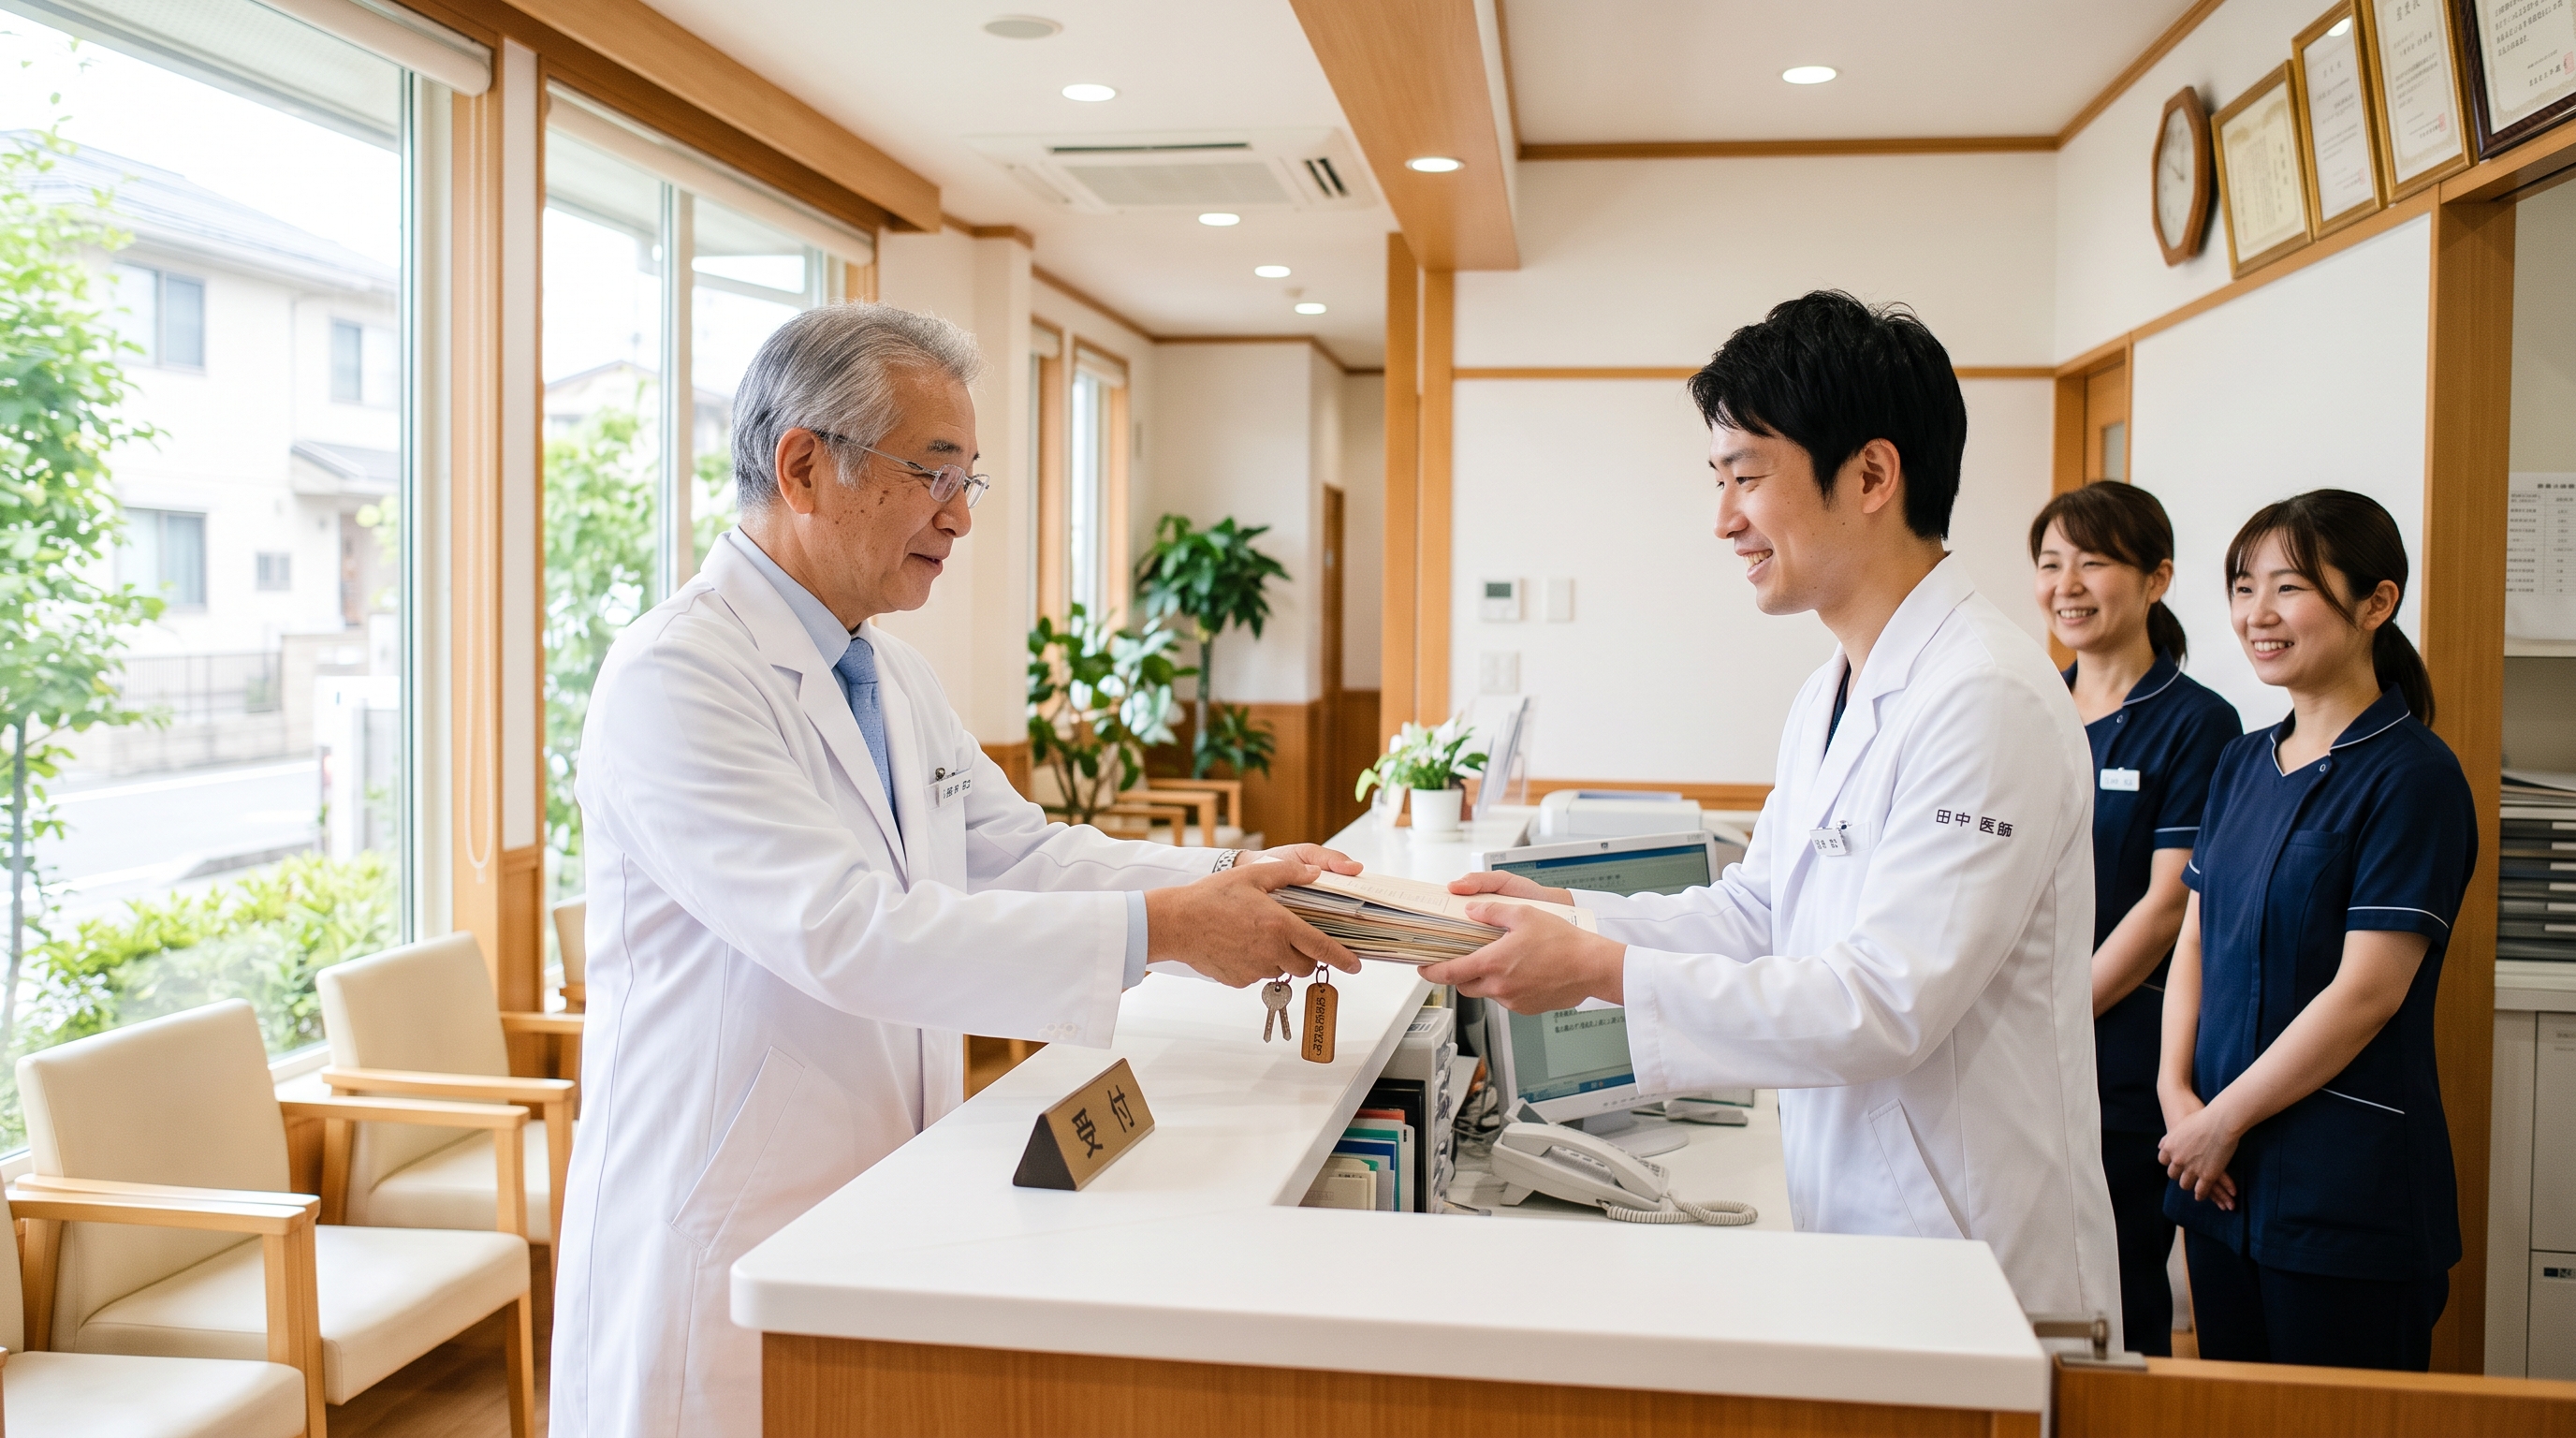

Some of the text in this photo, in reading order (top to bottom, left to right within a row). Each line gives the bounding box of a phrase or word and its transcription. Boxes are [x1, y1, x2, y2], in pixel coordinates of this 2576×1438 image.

[1936, 809, 2013, 838] 田中 医師
[1072, 1085, 1134, 1159] 受付
